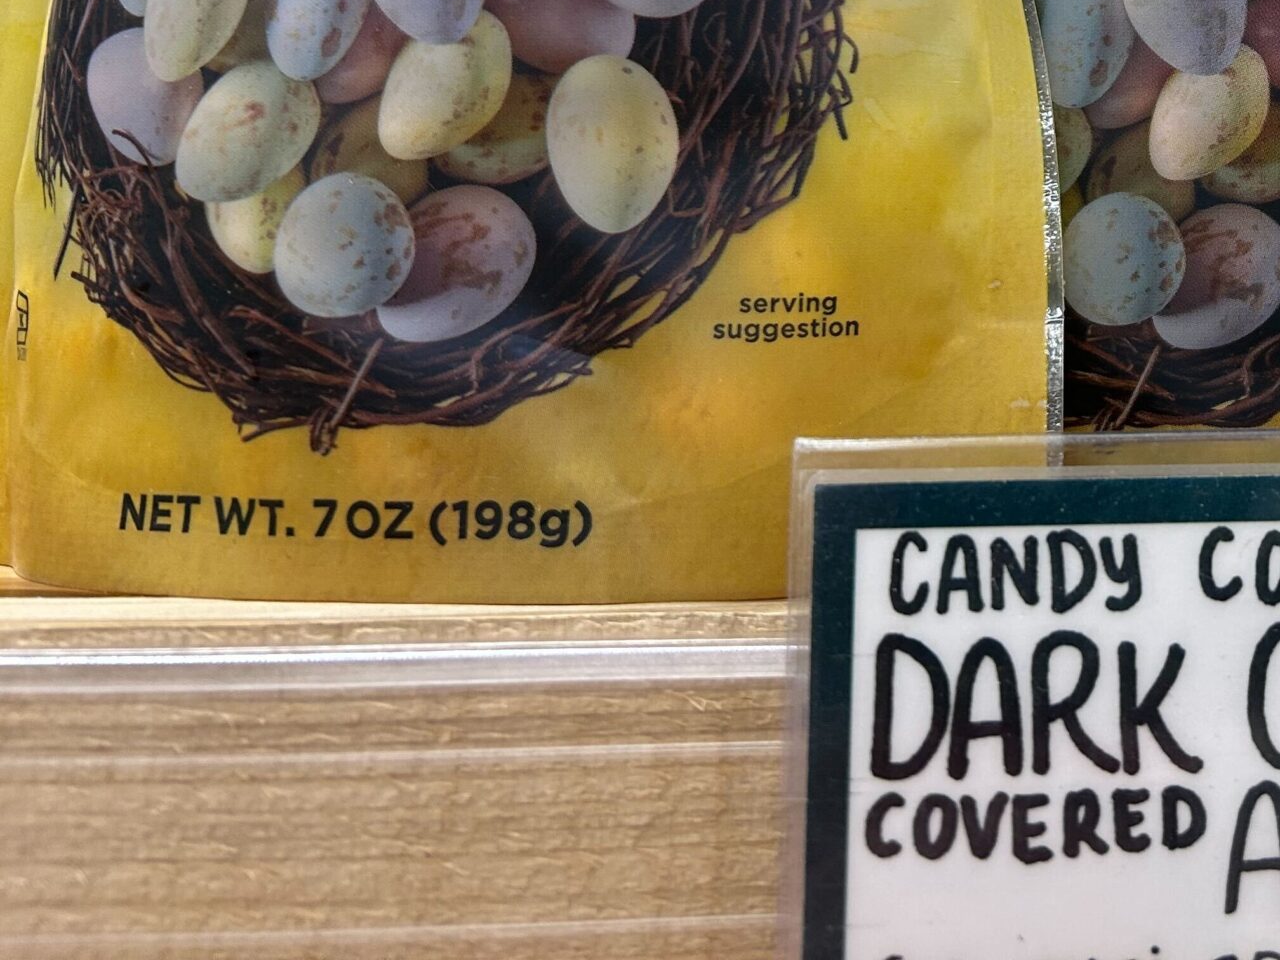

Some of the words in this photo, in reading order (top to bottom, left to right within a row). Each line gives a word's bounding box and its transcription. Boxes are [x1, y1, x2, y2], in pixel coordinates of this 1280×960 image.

[713, 317, 860, 343] suggestion
[739, 292, 838, 316] serving
[118, 492, 201, 534] NET
[213, 496, 296, 537] WT.
[428, 498, 594, 549] (198g)
[888, 530, 1143, 617] CANDY
[869, 631, 1204, 781] DARK
[864, 784, 1207, 865] COVERED
